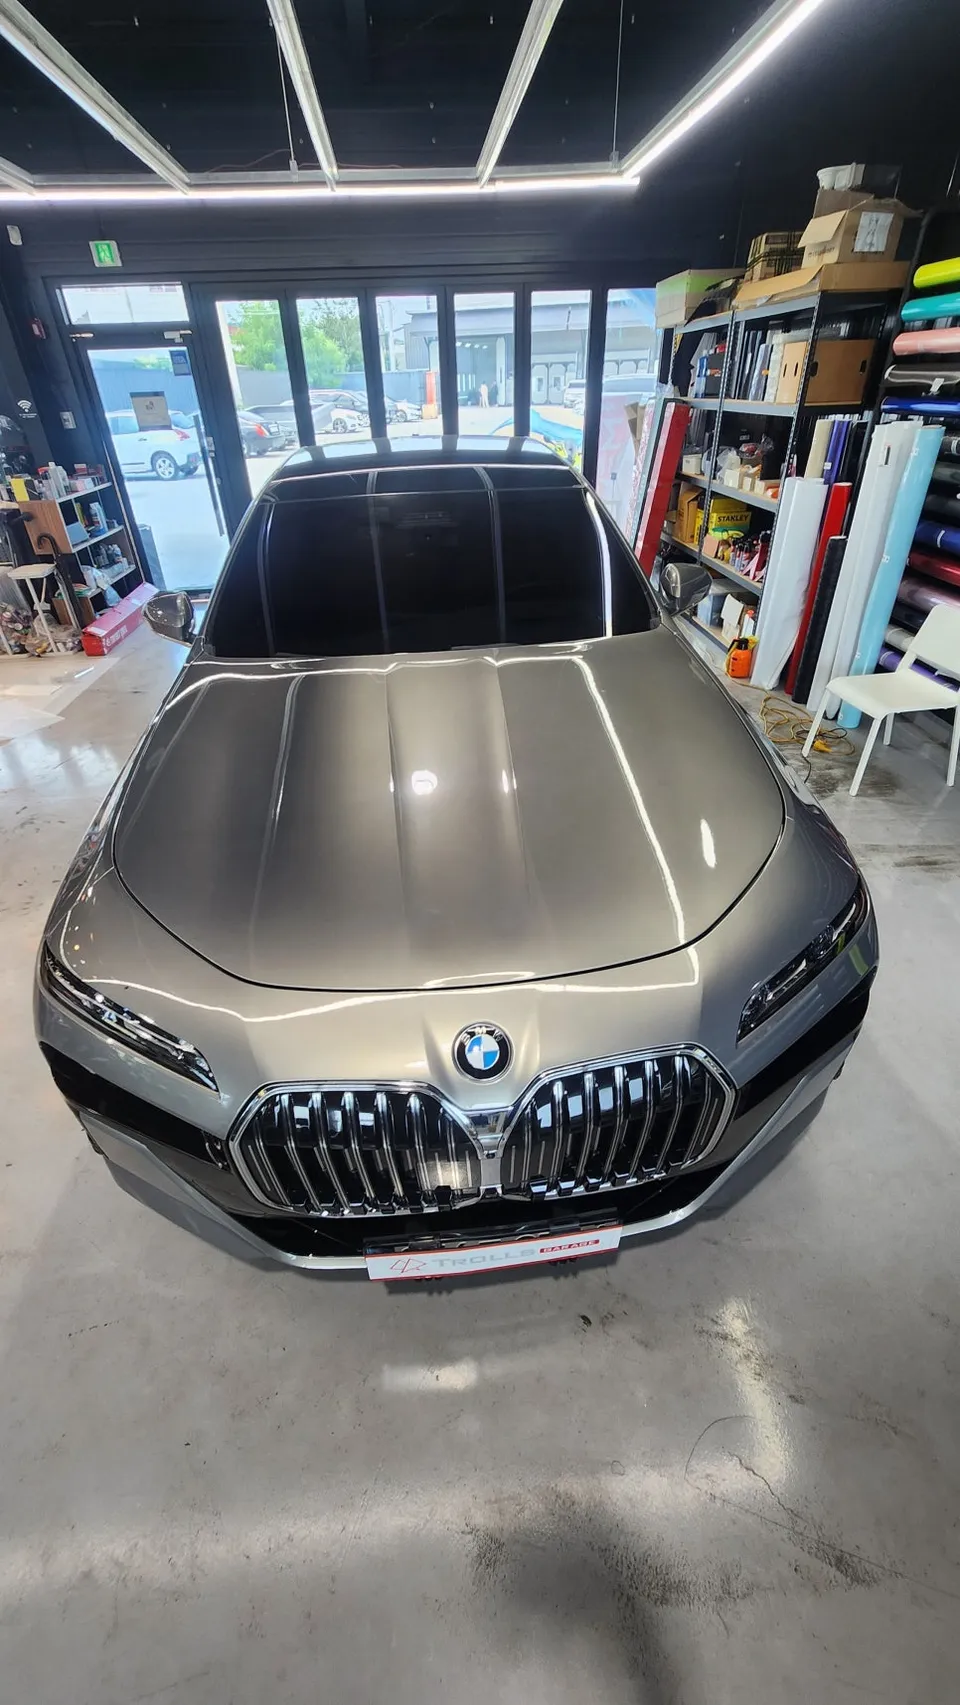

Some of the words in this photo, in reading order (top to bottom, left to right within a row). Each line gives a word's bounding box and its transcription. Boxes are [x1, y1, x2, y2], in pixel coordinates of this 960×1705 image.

[717, 514, 749, 523] STANLEY
[460, 1026, 504, 1045] BMW
[432, 1249, 535, 1267] TROLLS
[543, 1240, 598, 1252] GARAGE
